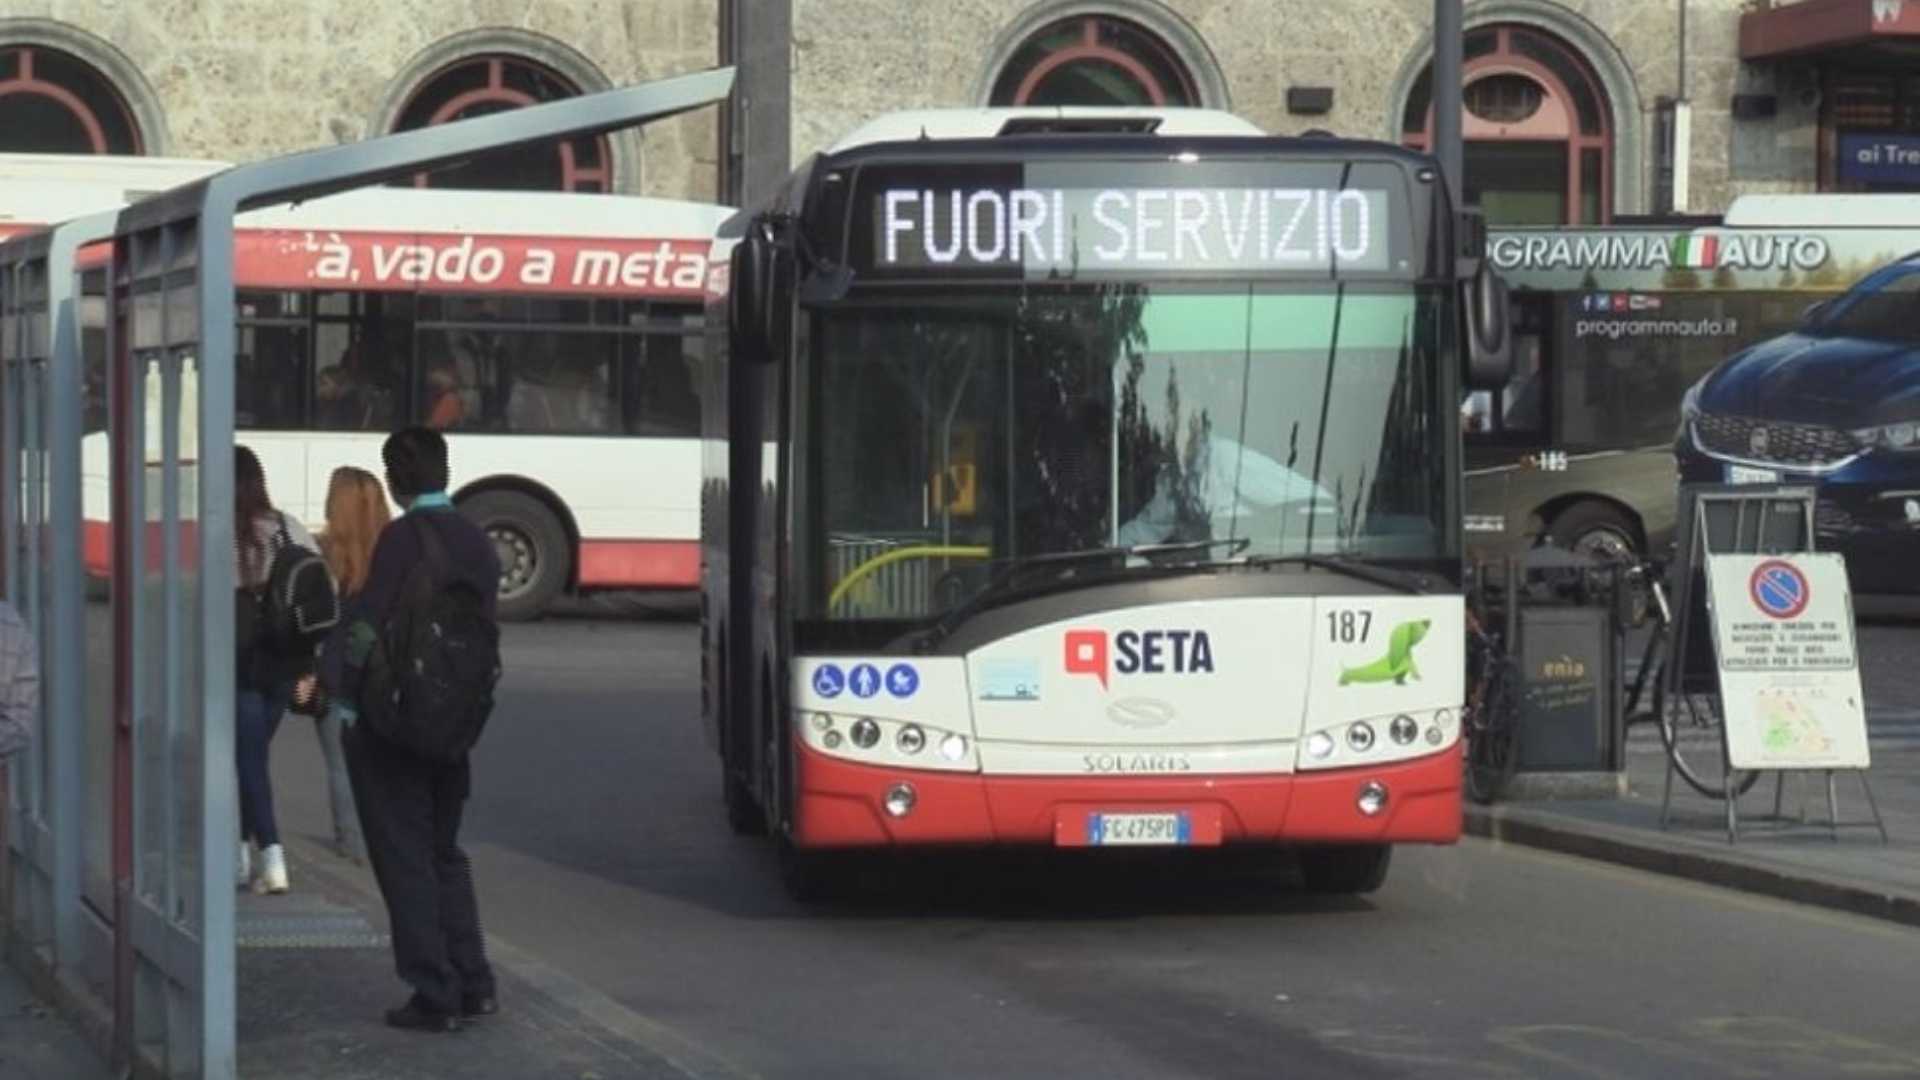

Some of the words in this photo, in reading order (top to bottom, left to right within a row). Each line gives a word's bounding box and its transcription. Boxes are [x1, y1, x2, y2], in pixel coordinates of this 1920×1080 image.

[885, 189, 1065, 263] FUORI
[1092, 188, 1371, 262] SERVIZIO
[371, 236, 505, 283] vado
[520, 248, 555, 284] a
[571, 241, 707, 290] meta
[1486, 236, 1672, 269] GRAMMA
[1718, 236, 1828, 269] AUTO
[1576, 317, 1738, 339] programmauto.it
[1327, 609, 1373, 643] 187
[1114, 630, 1215, 673] SETA
[1083, 755, 1190, 771] SOLARIS
